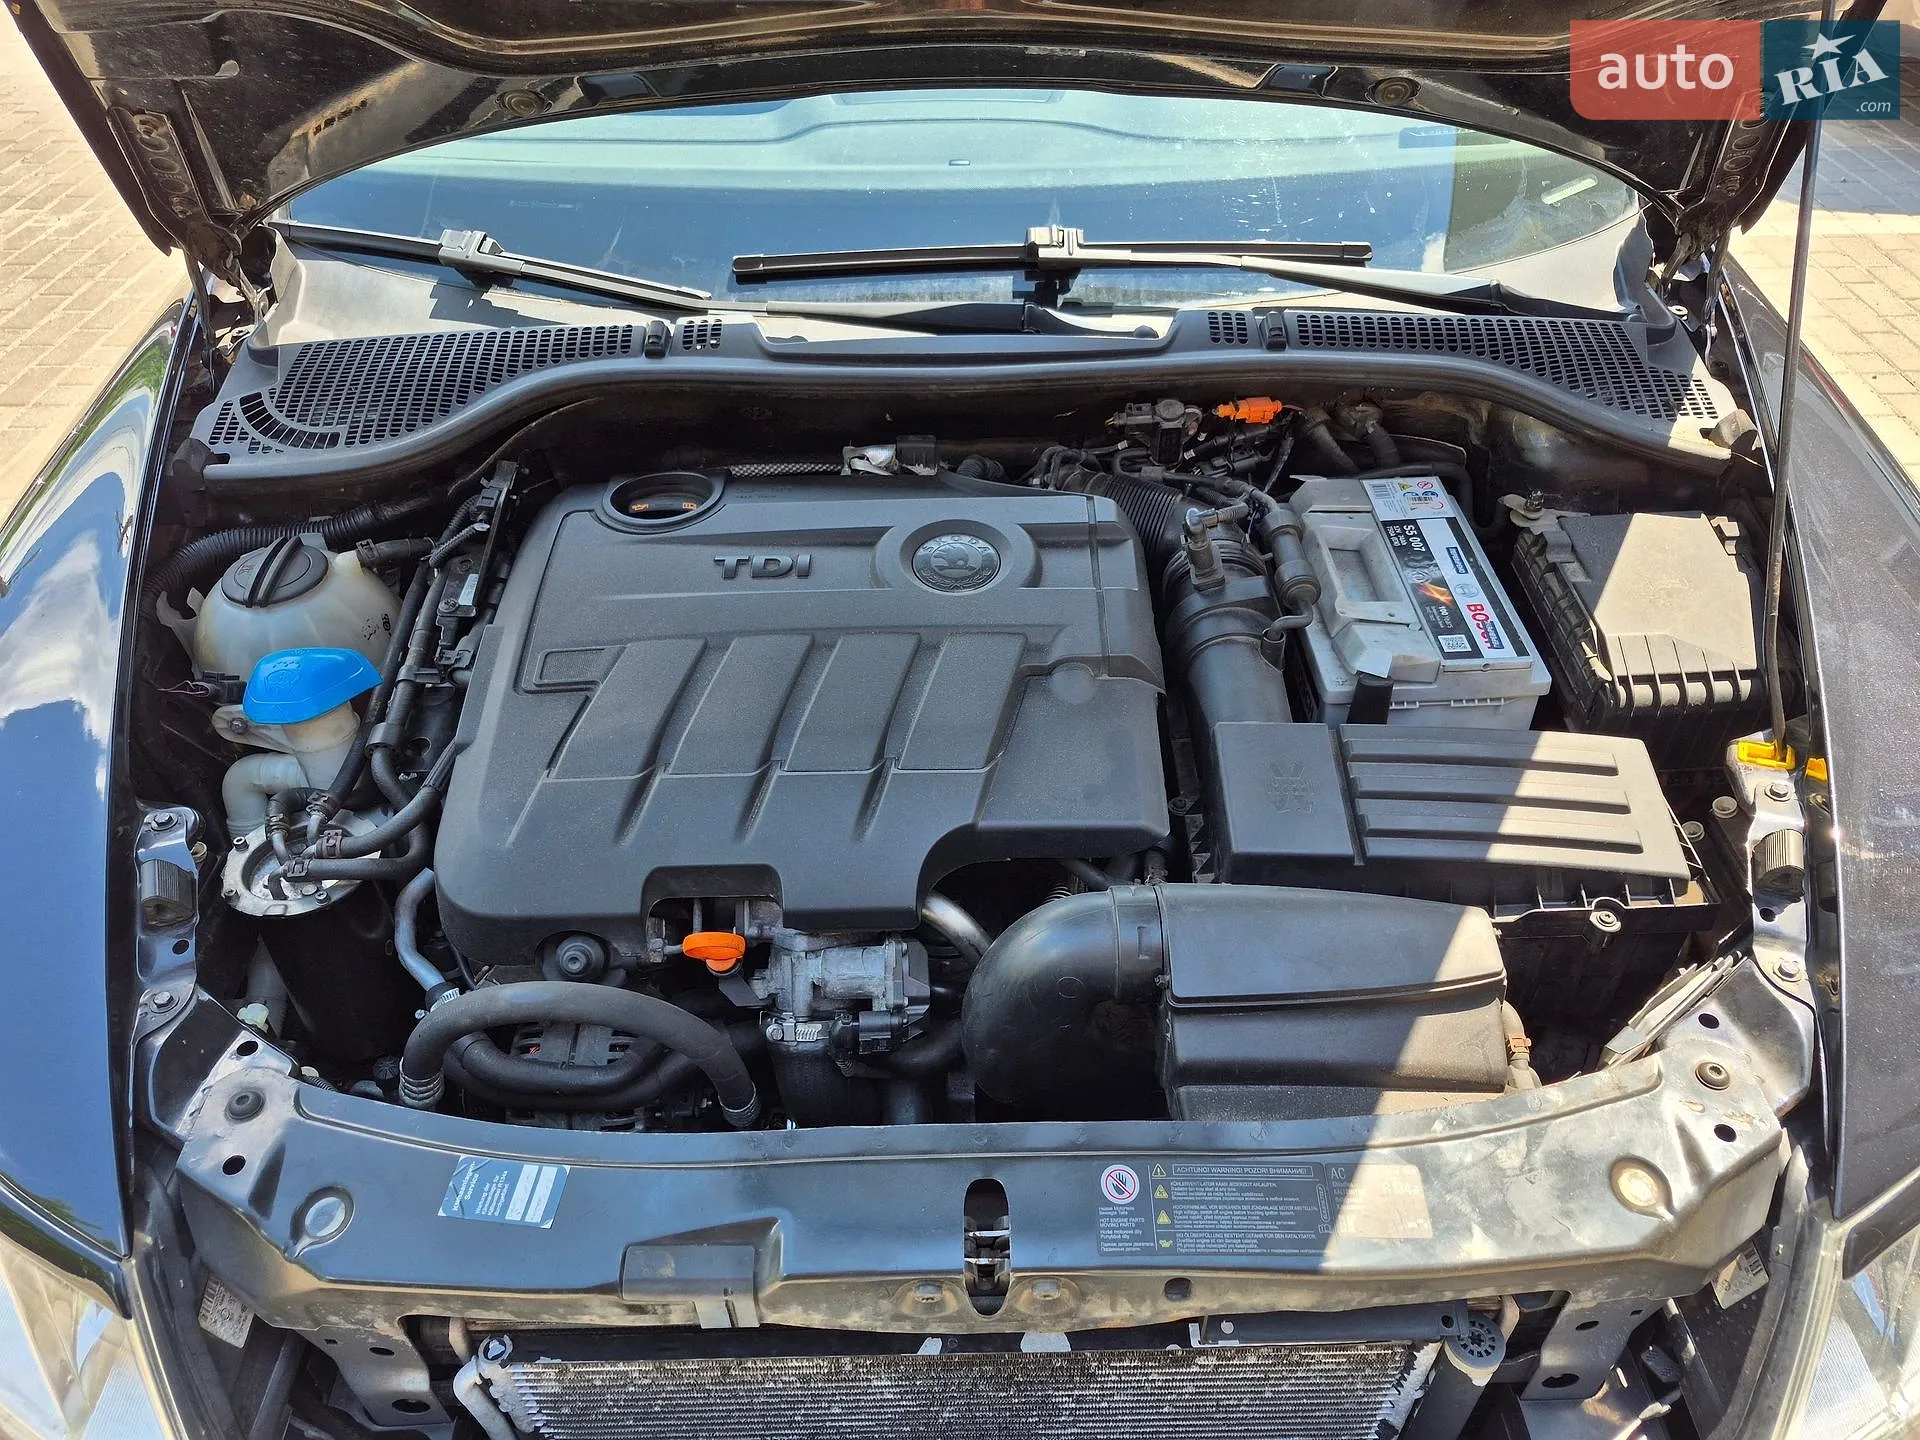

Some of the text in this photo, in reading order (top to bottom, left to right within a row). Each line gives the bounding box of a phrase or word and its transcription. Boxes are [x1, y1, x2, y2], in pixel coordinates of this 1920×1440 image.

[1403, 524, 1426, 552] S5 007
[714, 553, 812, 579] TDI
[1211, 1166, 1243, 1174] WARNING!
[1331, 1167, 1346, 1180] AC
